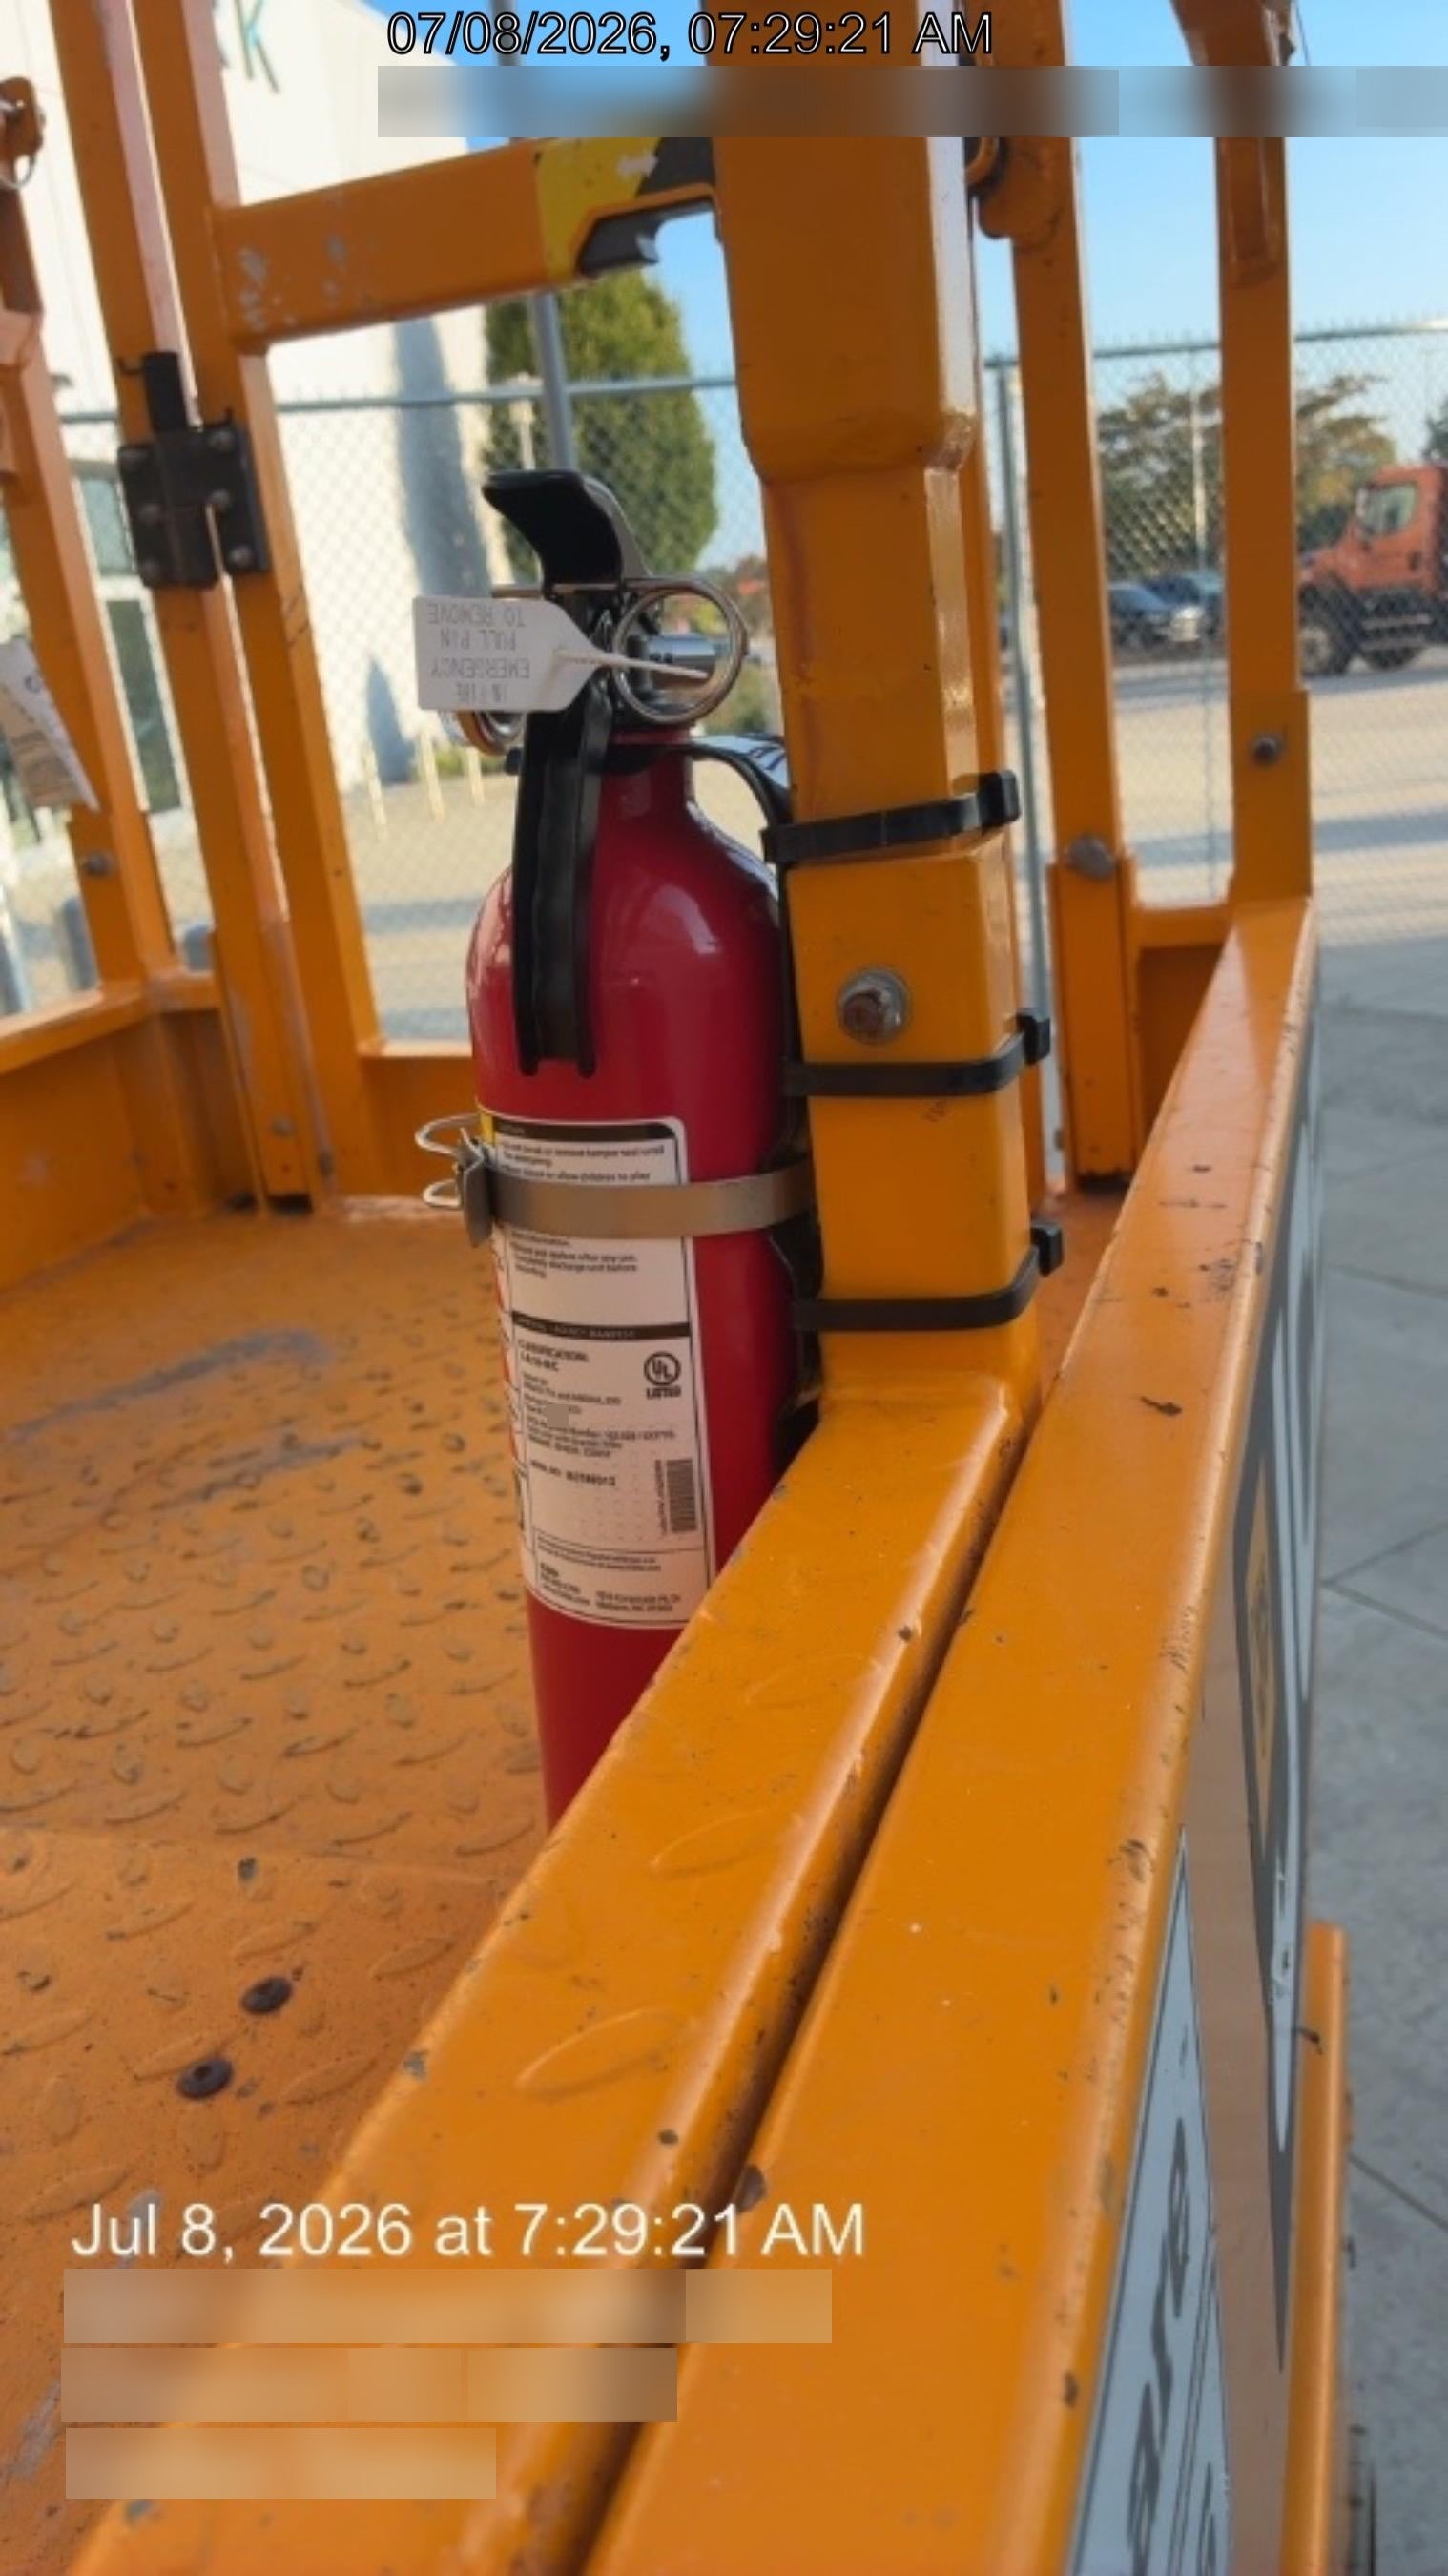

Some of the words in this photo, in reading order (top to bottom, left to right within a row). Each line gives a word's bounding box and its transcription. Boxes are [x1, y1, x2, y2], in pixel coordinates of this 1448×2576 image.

[428, 602, 493, 627] REMOVE
[502, 605, 527, 627] TO
[440, 628, 470, 650] PIN
[479, 629, 516, 651] PULL
[430, 657, 531, 679] EMERGENCY
